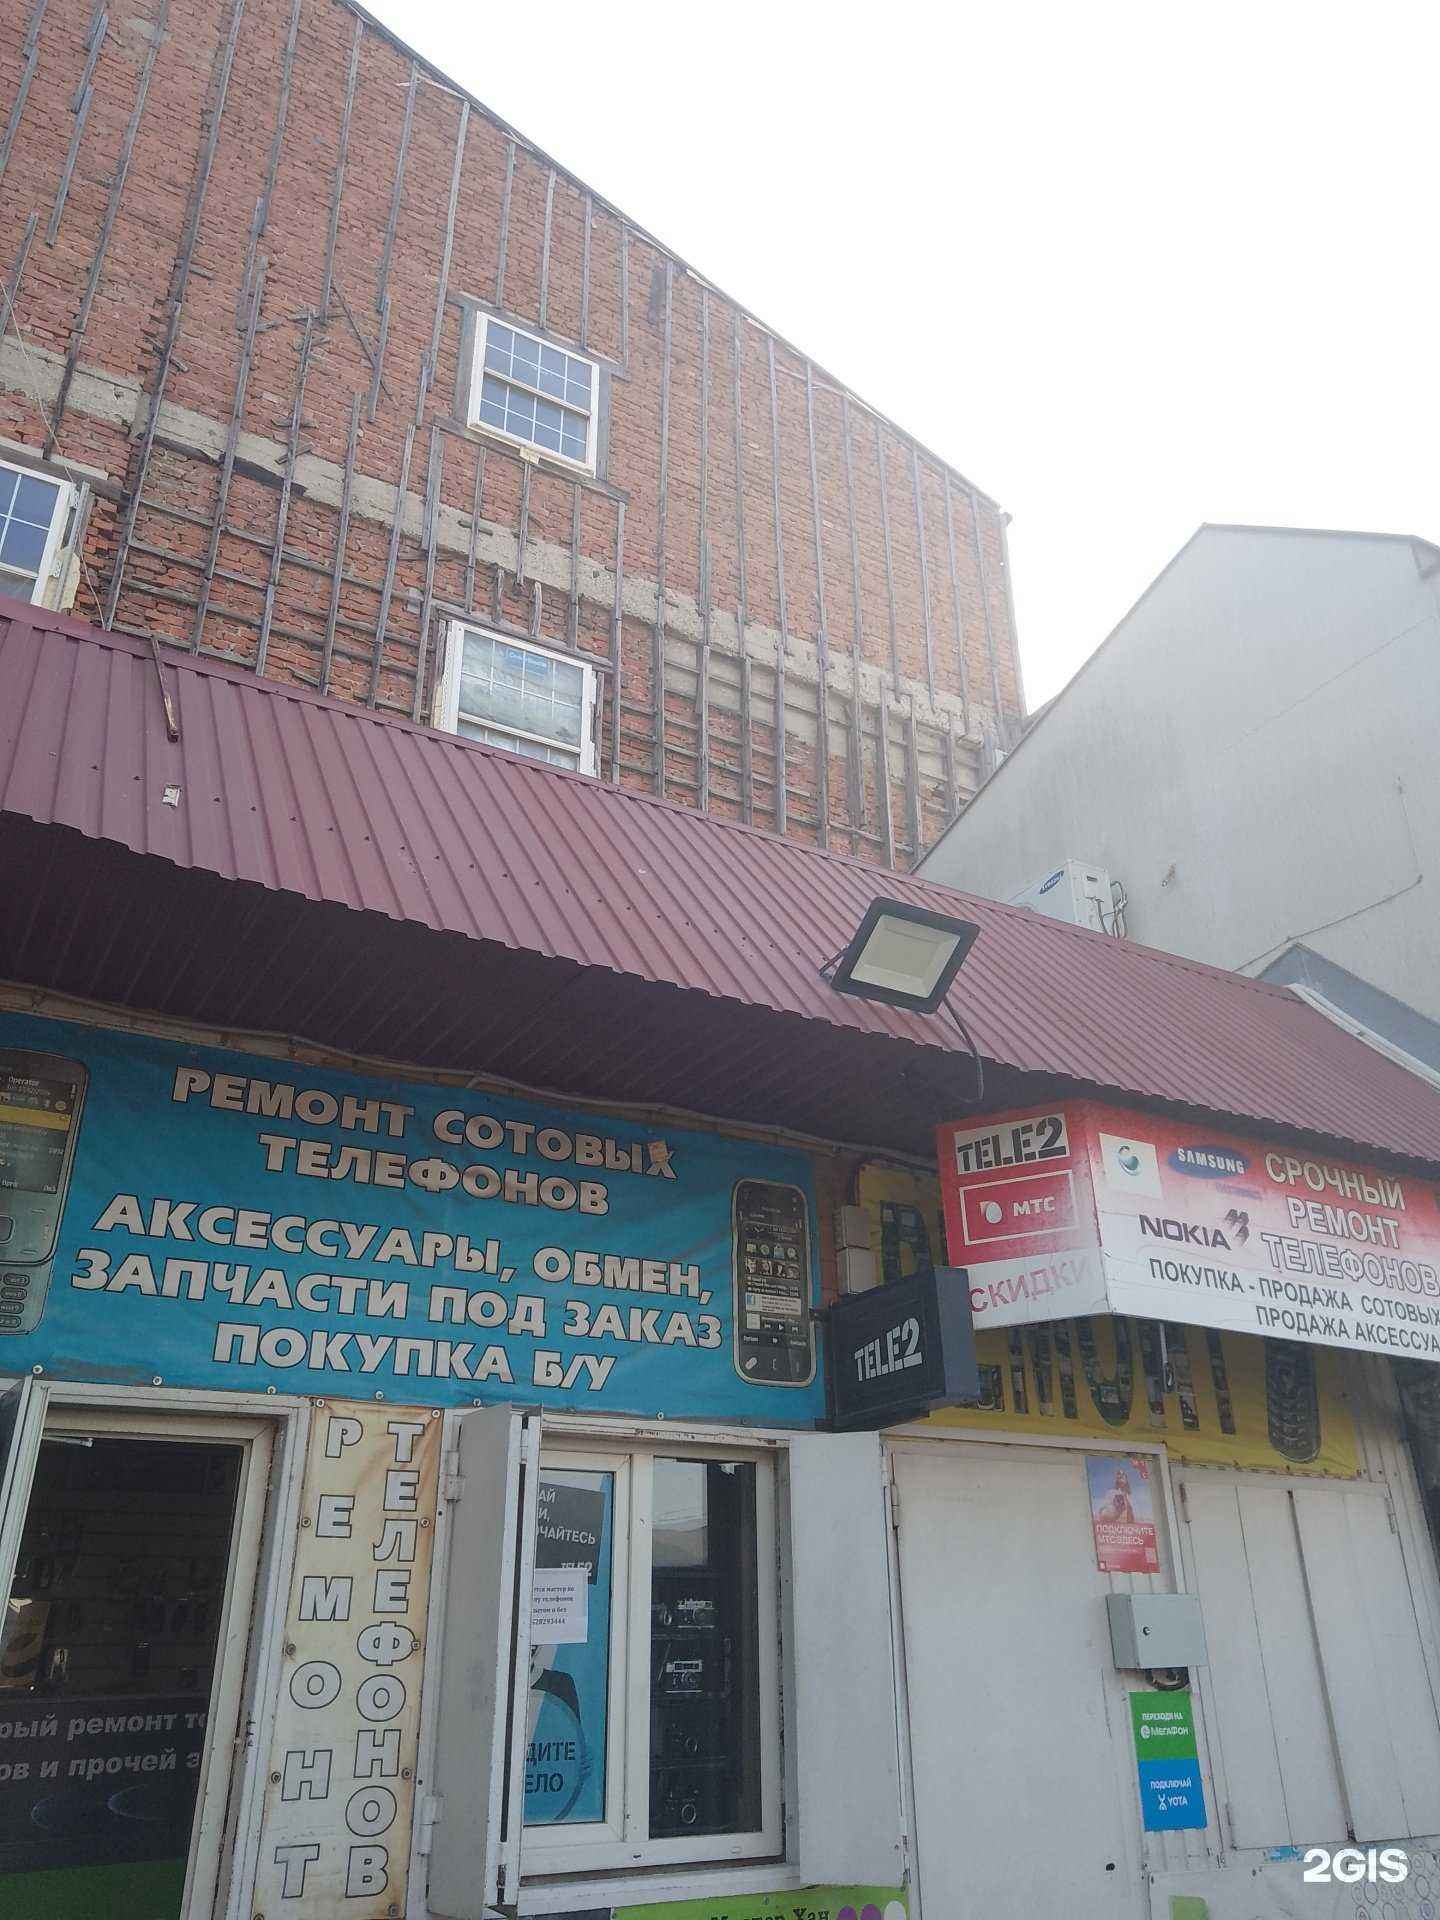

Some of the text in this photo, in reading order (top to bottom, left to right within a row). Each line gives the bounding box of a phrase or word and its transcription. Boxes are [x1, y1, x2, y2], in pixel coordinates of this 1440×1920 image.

[171, 1065, 678, 1179] РЕМОНТ СОТОВЫХ
[957, 1116, 1067, 1172] TELE2
[259, 1134, 609, 1216] ТЕЛЕФОНОВ
[1177, 1147, 1246, 1175] SAMSUNG
[1264, 1152, 1406, 1211] СРОЧНЫЙ
[1013, 1196, 1056, 1217] МТС
[1138, 1214, 1232, 1251] NOKIA
[1286, 1195, 1400, 1249] РЕМОНТ
[92, 1193, 714, 1306] АКСЕССУАРЫ, ОБМЕН,
[1260, 1232, 1440, 1297] ТЕЛЕФОНОВ
[70, 1248, 722, 1350] ЗАПЧАСТИ ПОД ЗАКАЗ
[1149, 1257, 1245, 1294] ПОКУПКА
[1258, 1276, 1353, 1312] ПРОДАЖА
[854, 1317, 923, 1382] TELE2
[1255, 1305, 1350, 1339] ПРОДАЖА
[212, 1321, 617, 1391] ПОКУПКА Б/У
[539, 1488, 556, 1503] АЙ
[274, 1416, 364, 1899] РЕМОНТ
[344, 1420, 426, 1899] ТЕЛЕФОНОВ
[66, 1714, 177, 1741] ремонт
[526, 1741, 576, 1766] ДИТЕ
[40, 1760, 60, 1778] и
[68, 1748, 177, 1781] прочей
[525, 1772, 564, 1794] ЕЛО
[1168, 1796, 1188, 1806] YOTA
